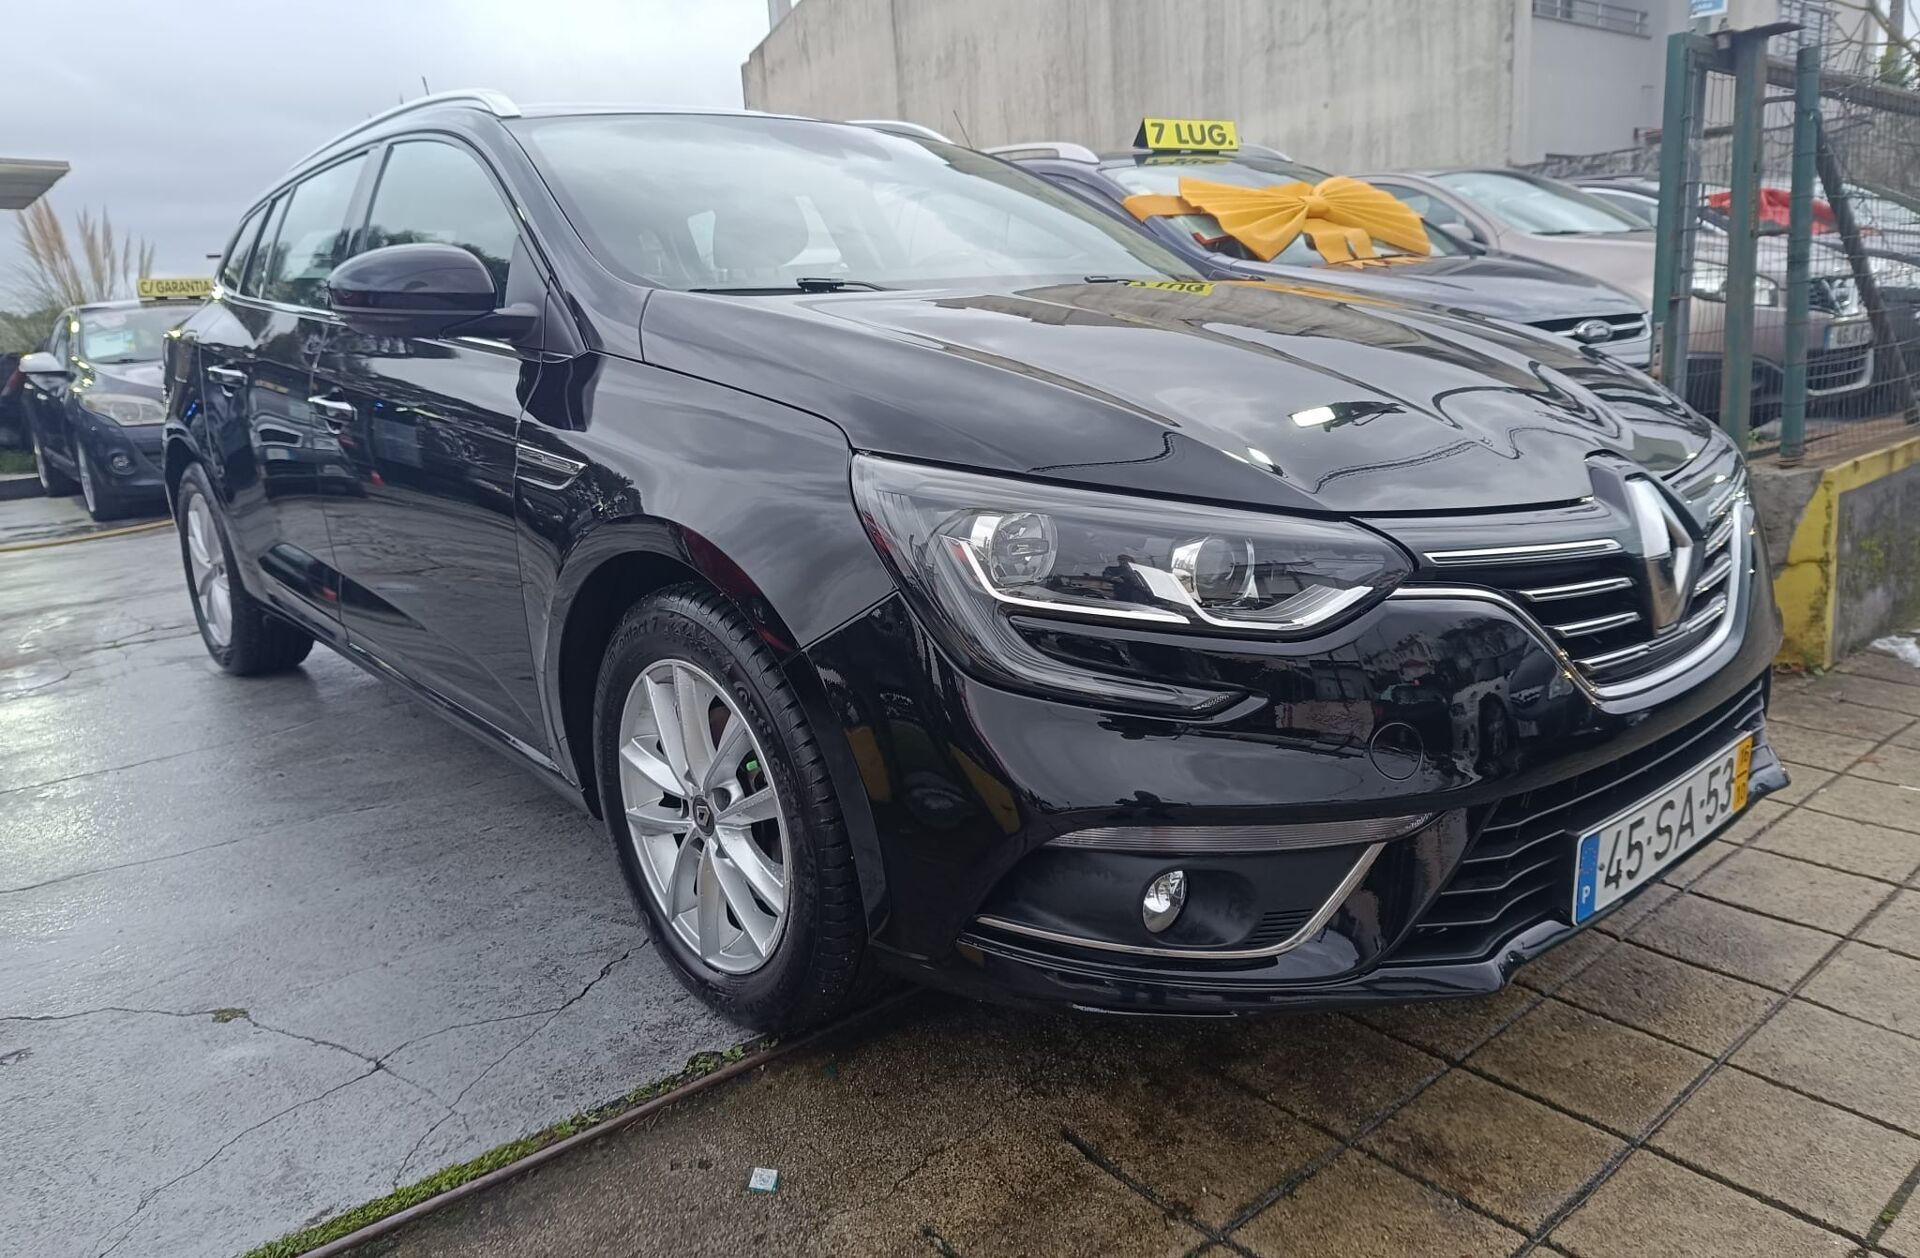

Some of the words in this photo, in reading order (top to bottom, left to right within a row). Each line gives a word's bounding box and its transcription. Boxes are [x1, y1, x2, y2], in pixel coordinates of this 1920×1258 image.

[1150, 122, 1165, 145] 7
[1174, 123, 1234, 146] LUG.
[155, 280, 210, 293] GARANTIA
[1581, 885, 1591, 905] P
